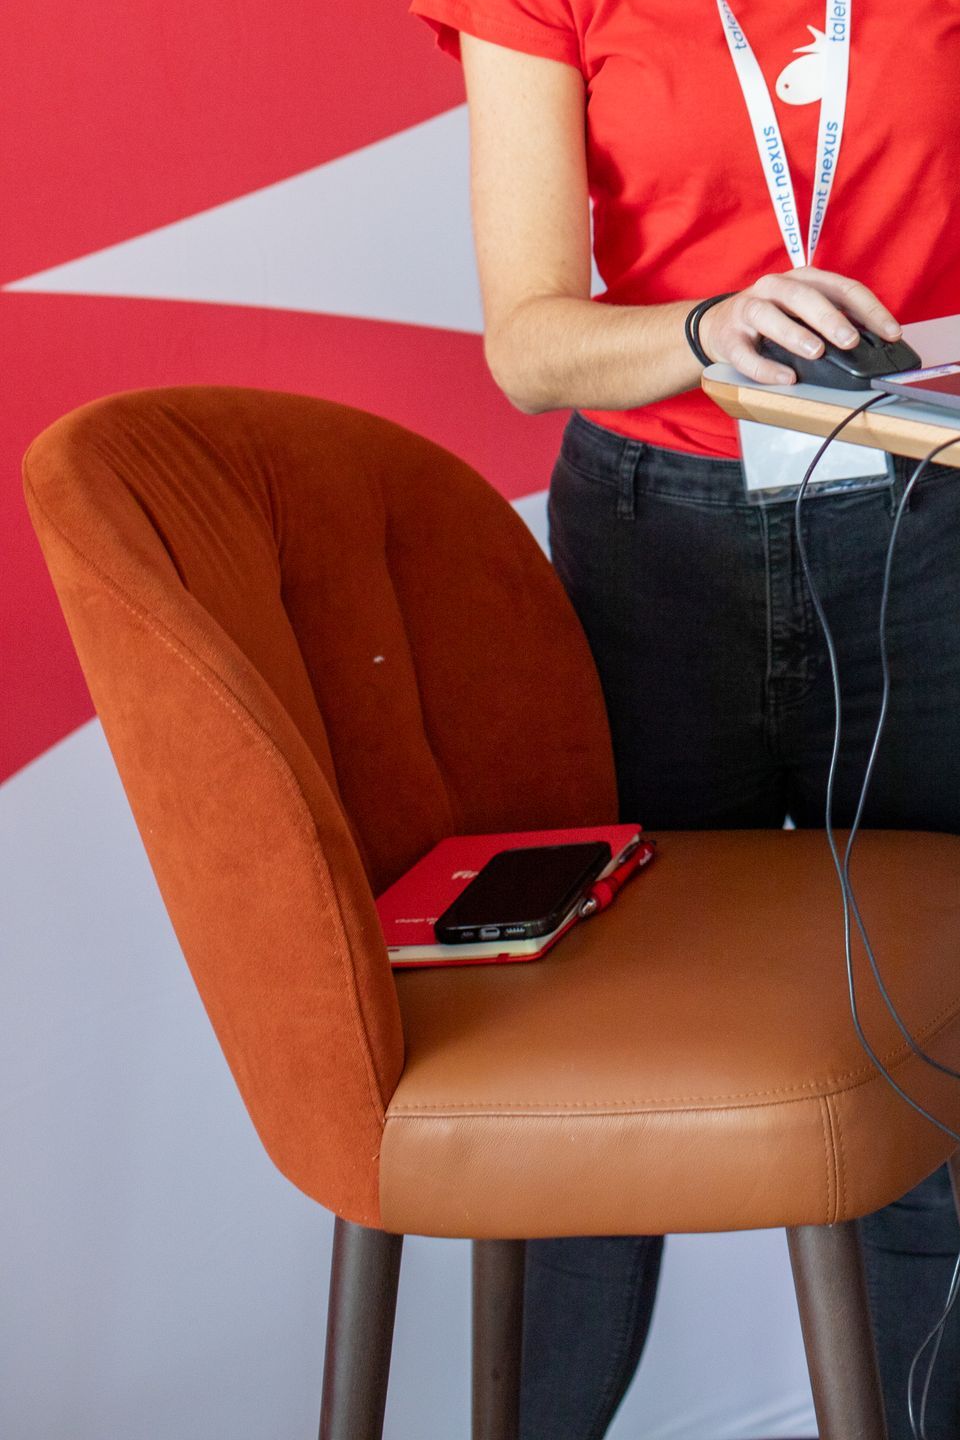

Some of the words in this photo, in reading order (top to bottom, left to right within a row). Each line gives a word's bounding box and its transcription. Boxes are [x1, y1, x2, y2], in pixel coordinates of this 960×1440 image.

[763, 125, 788, 188] nexus
[809, 188, 828, 251] talent
[820, 121, 839, 184] nexus
[776, 191, 801, 255] talent
